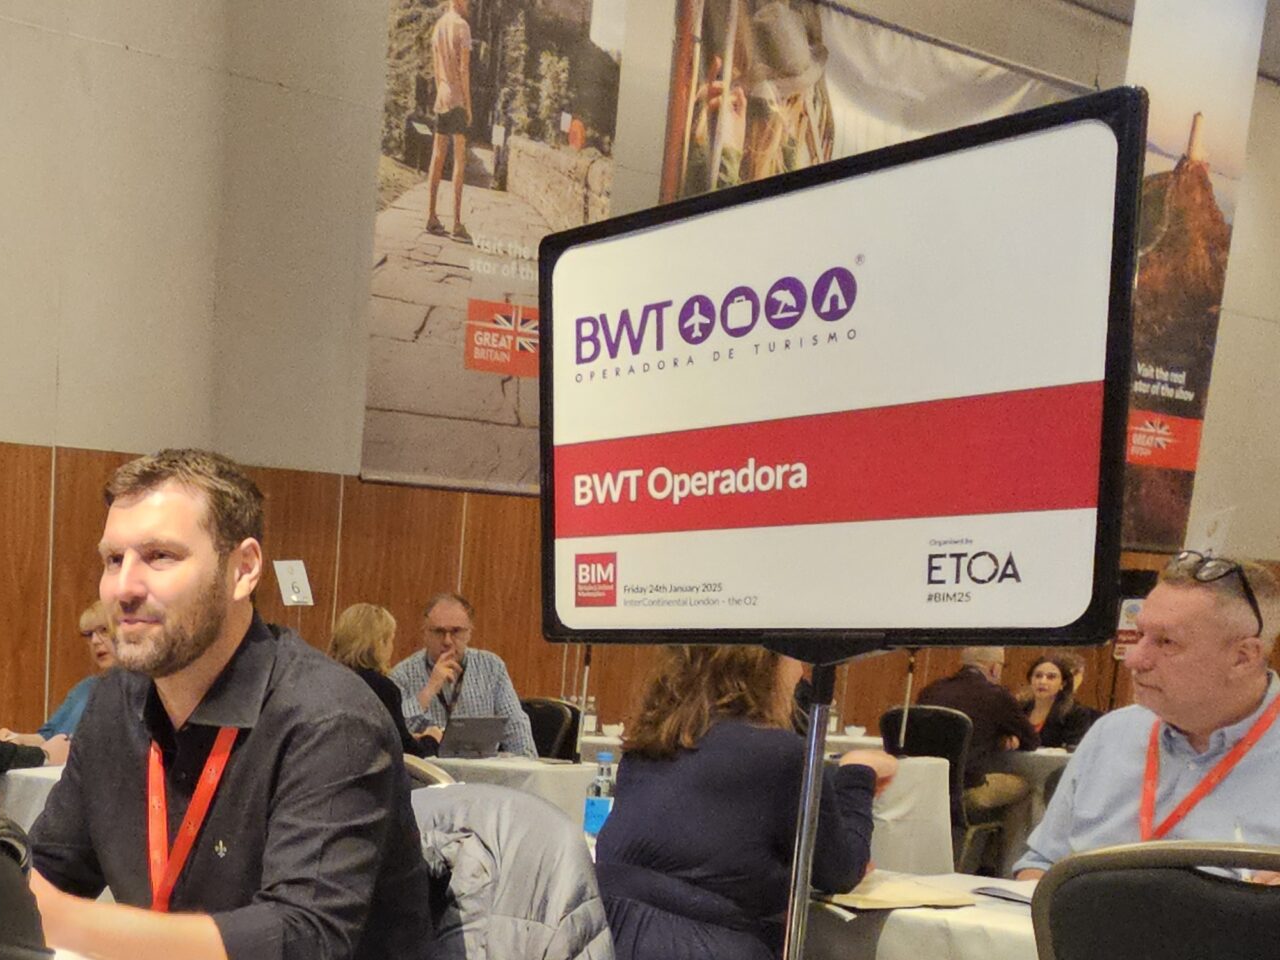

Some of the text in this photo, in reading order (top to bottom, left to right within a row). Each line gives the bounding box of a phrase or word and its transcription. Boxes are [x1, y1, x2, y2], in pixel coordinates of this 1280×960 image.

[474, 331, 513, 350] GREAT
[575, 300, 673, 365] BWT
[473, 346, 511, 362] BRITAIN
[575, 329, 857, 383] OPERADORA DE TURISMO
[574, 457, 807, 506] BWT Operadora
[578, 563, 614, 583] BIM
[927, 551, 1022, 585] ETOA
[291, 581, 300, 594] 6
[623, 585, 646, 596] Friday
[648, 583, 667, 594] 24th
[669, 582, 700, 594] January
[701, 582, 723, 593] 2025
[927, 591, 972, 603] #BIM25
[623, 598, 689, 608] InterContinental
[689, 597, 720, 607] London
[728, 597, 742, 607] the
[743, 596, 758, 606] O2
